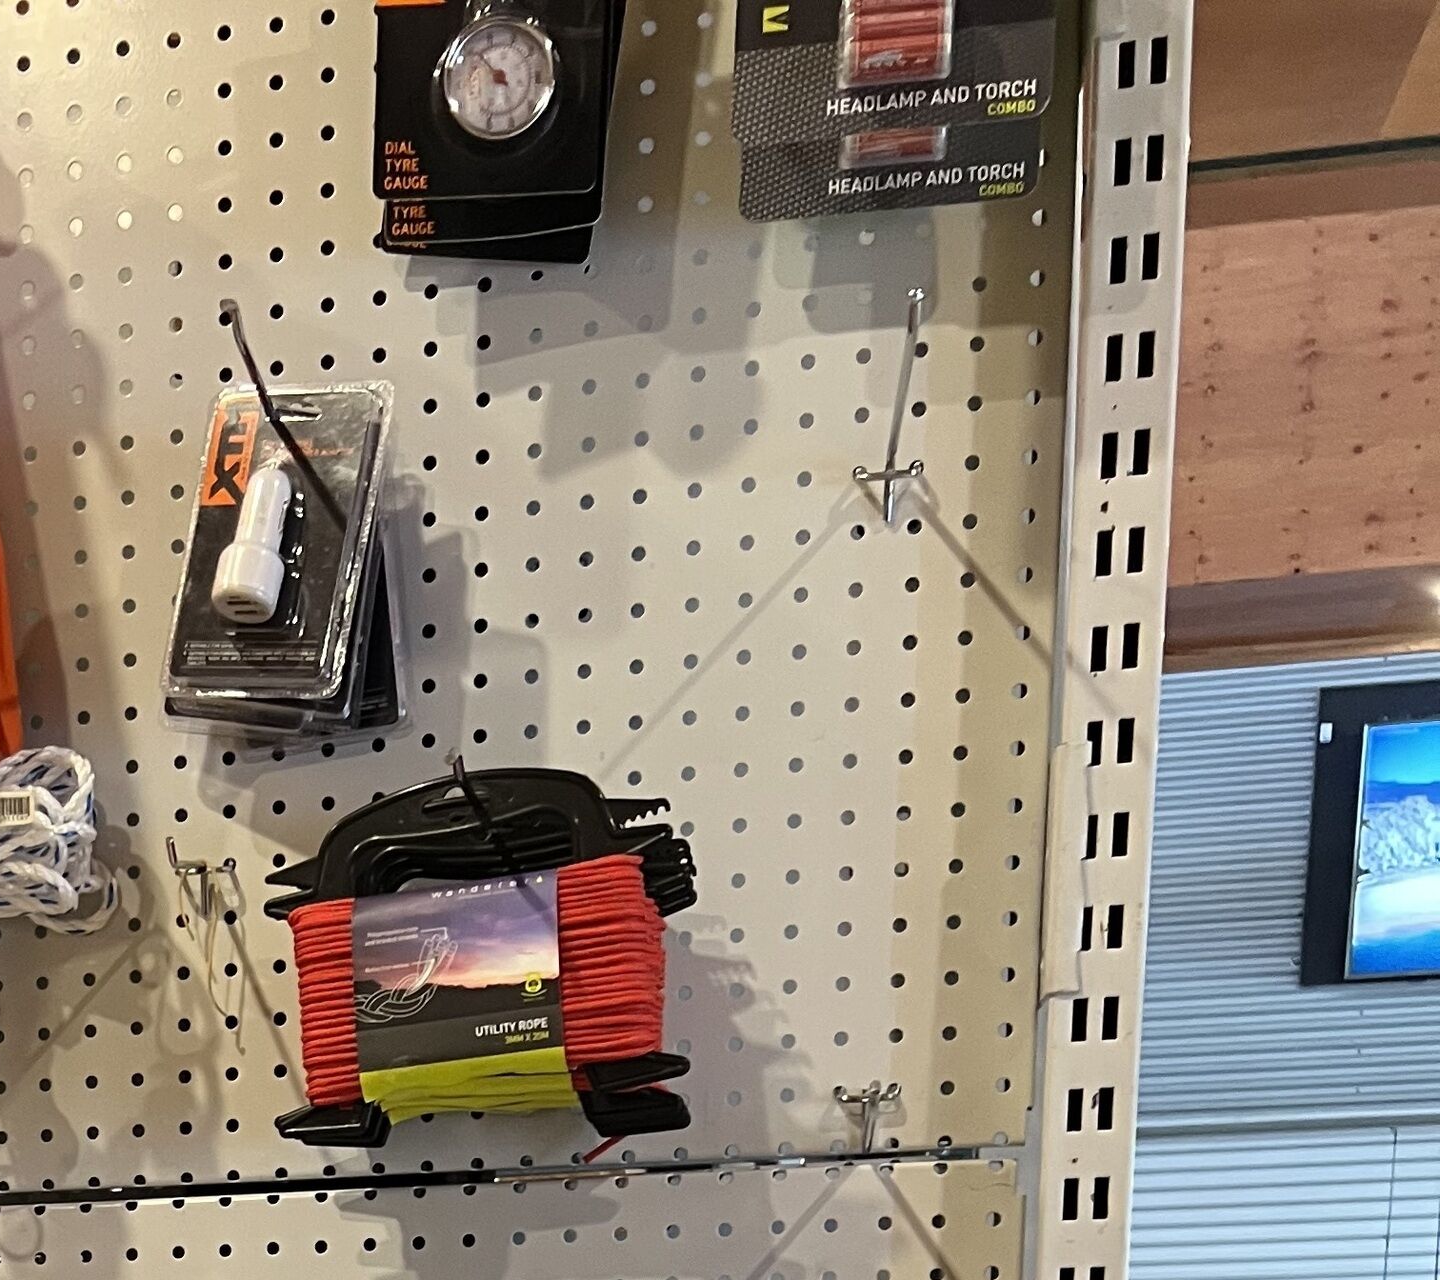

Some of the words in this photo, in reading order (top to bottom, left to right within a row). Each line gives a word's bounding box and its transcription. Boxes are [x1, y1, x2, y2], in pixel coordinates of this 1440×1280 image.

[827, 90, 927, 116] HEADLAMP
[931, 85, 969, 106] AND
[975, 79, 1036, 101] TORCH
[987, 99, 1036, 116] COMBO
[385, 141, 416, 155] DIAL
[385, 158, 420, 172] TYRE
[384, 175, 429, 190] GAUGE
[828, 171, 923, 196] HEADLAMP
[926, 166, 962, 186] AND
[970, 161, 1025, 182] TORCH
[978, 181, 1024, 197] COMBO
[393, 205, 426, 219] TYRE
[392, 221, 436, 235] GAUGE
[475, 1022, 517, 1037] UTILITY
[518, 1017, 549, 1031] ROPE
